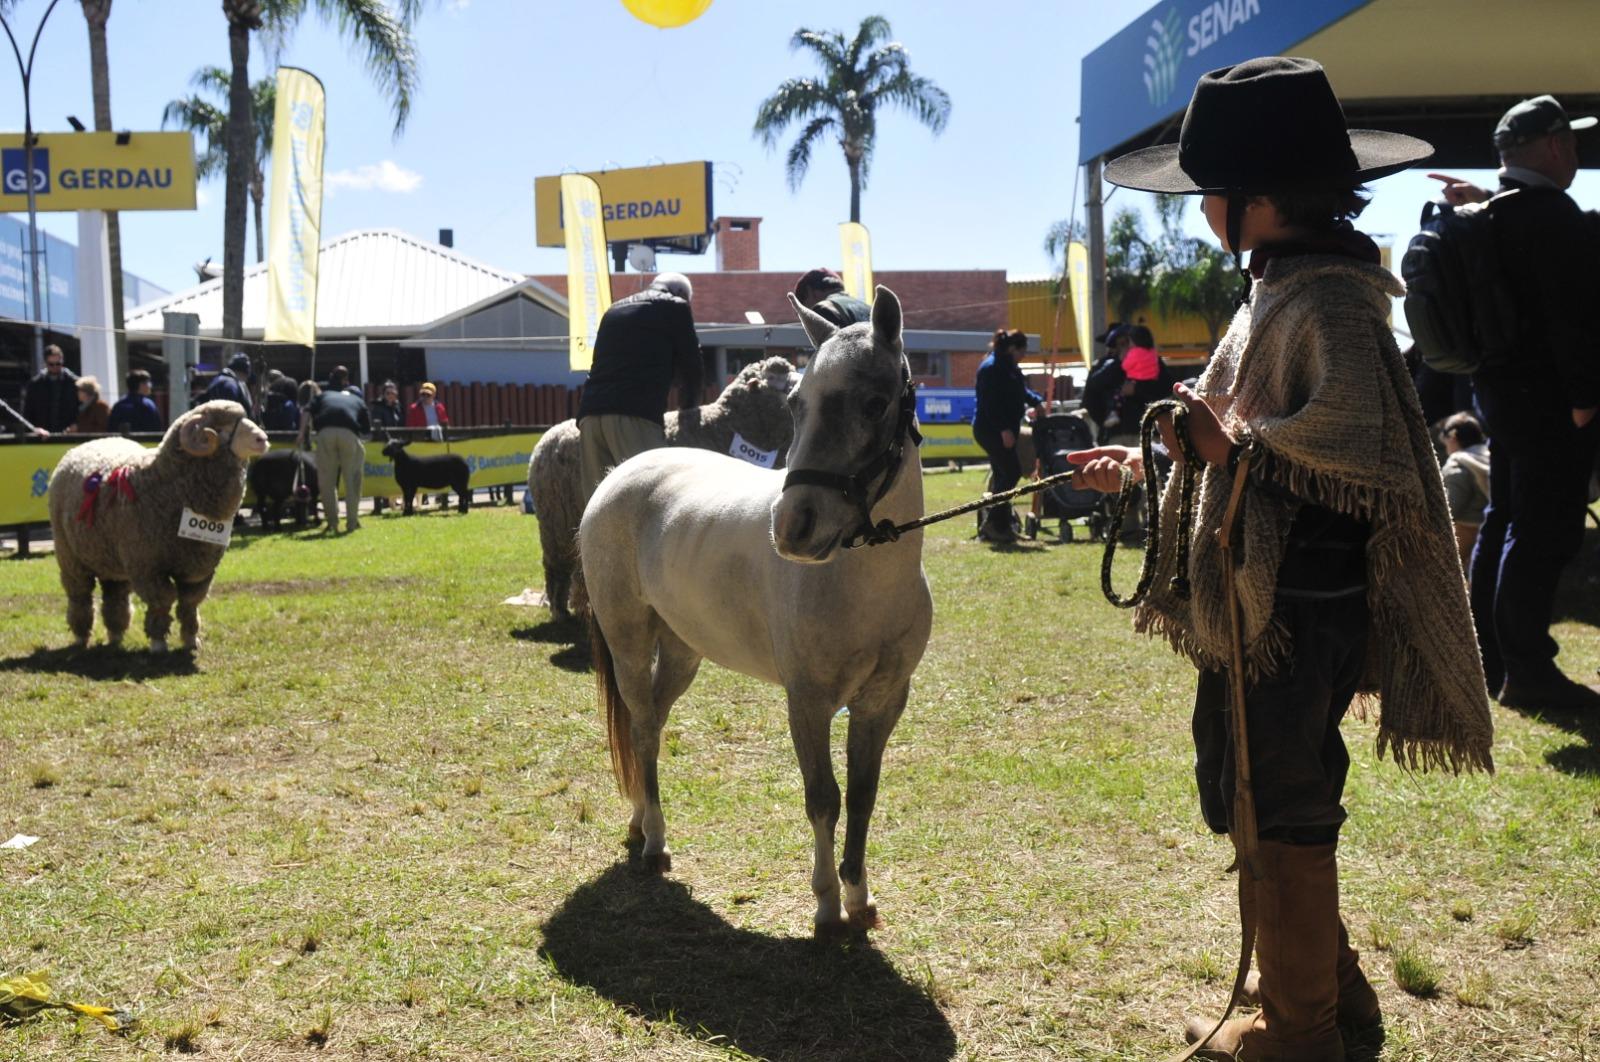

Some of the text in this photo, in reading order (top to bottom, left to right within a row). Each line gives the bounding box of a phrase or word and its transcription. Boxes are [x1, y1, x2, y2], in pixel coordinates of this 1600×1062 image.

[59, 168, 172, 189] GERDAU
[603, 198, 681, 221] GERDAU
[740, 444, 768, 462] 0015
[189, 517, 224, 533] 0009
